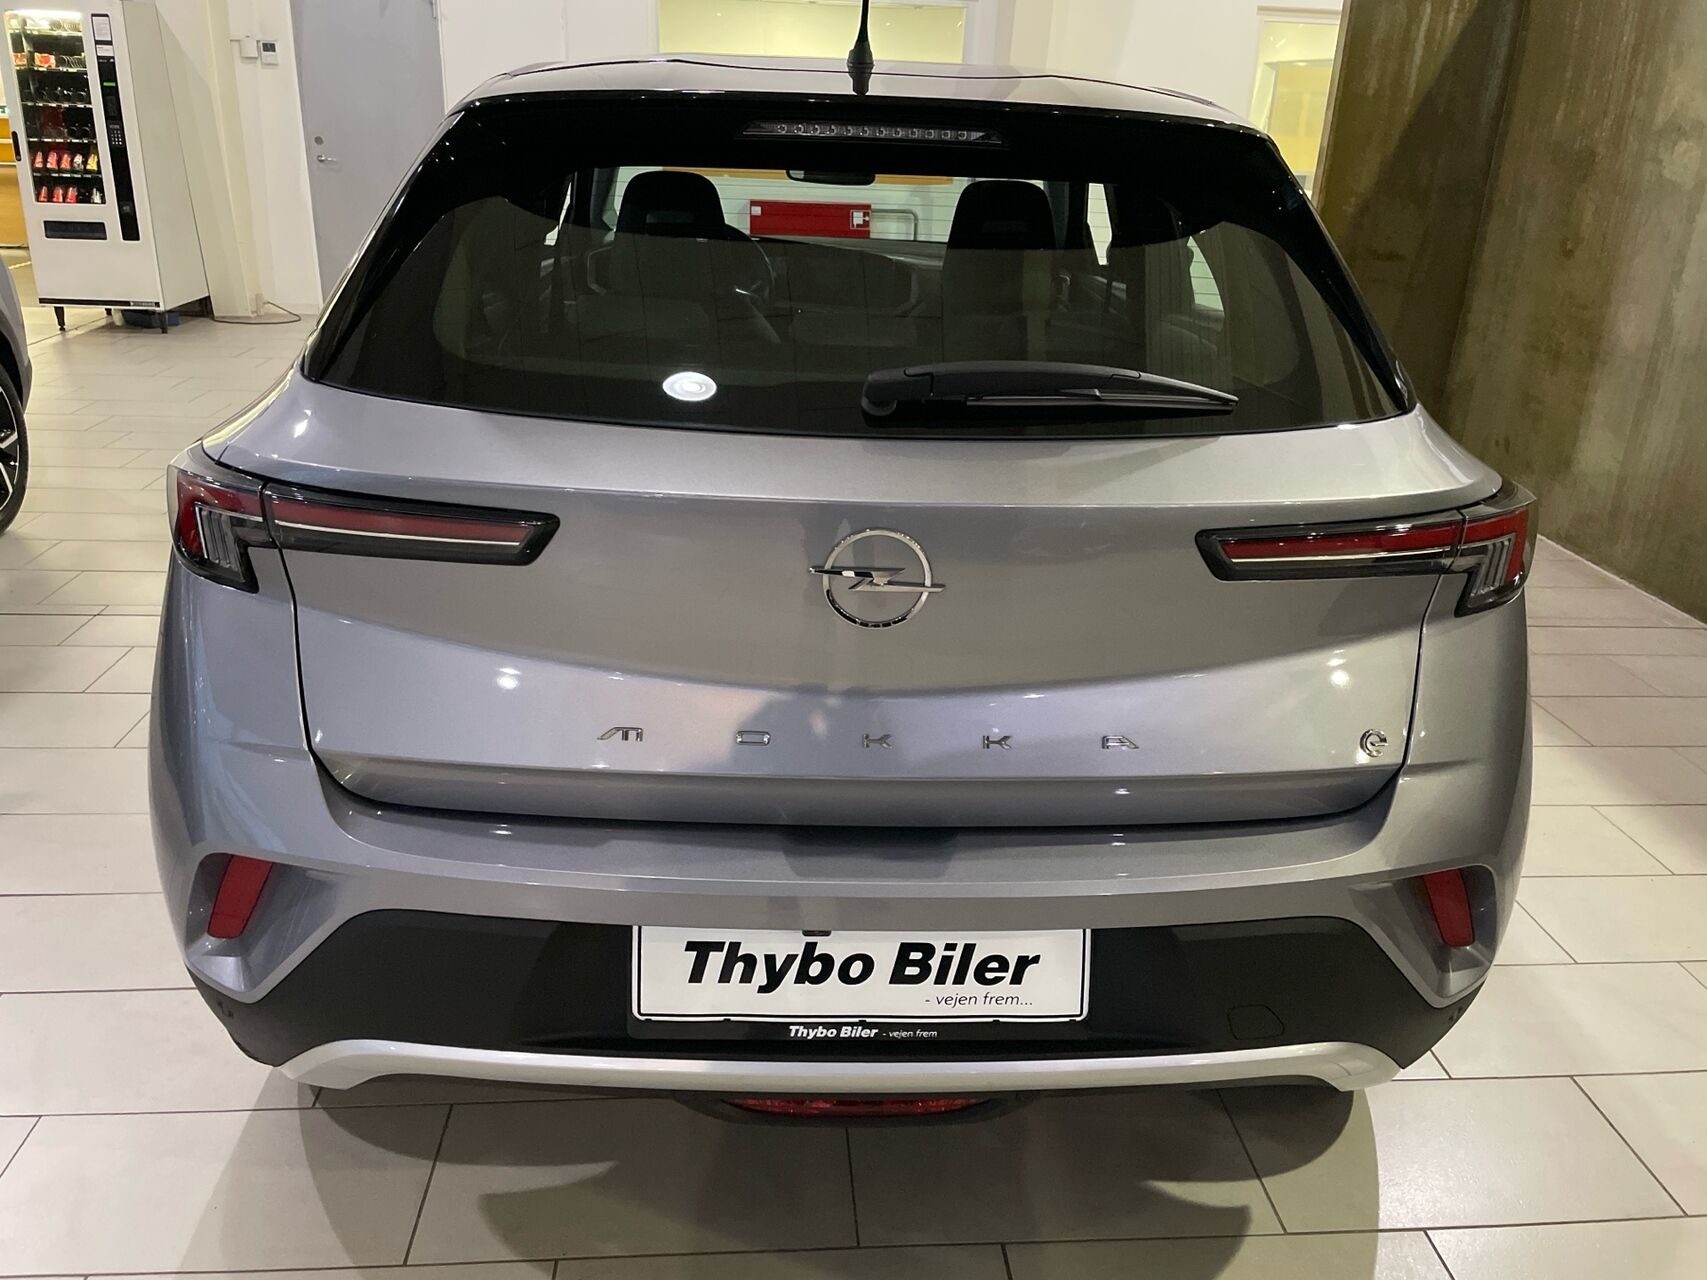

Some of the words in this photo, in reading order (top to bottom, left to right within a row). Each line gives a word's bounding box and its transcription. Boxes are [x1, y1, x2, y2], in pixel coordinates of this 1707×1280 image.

[597, 726, 1140, 750] MOKKA
[684, 940, 875, 994] Thybo
[888, 941, 1041, 987] Biler
[936, 992, 978, 1009] vejen
[983, 991, 1033, 1007] frem...
[789, 1025, 837, 1040] Thybo
[840, 1025, 879, 1038] Biler
[888, 1029, 913, 1040] vejen
[915, 1028, 938, 1038] frem
